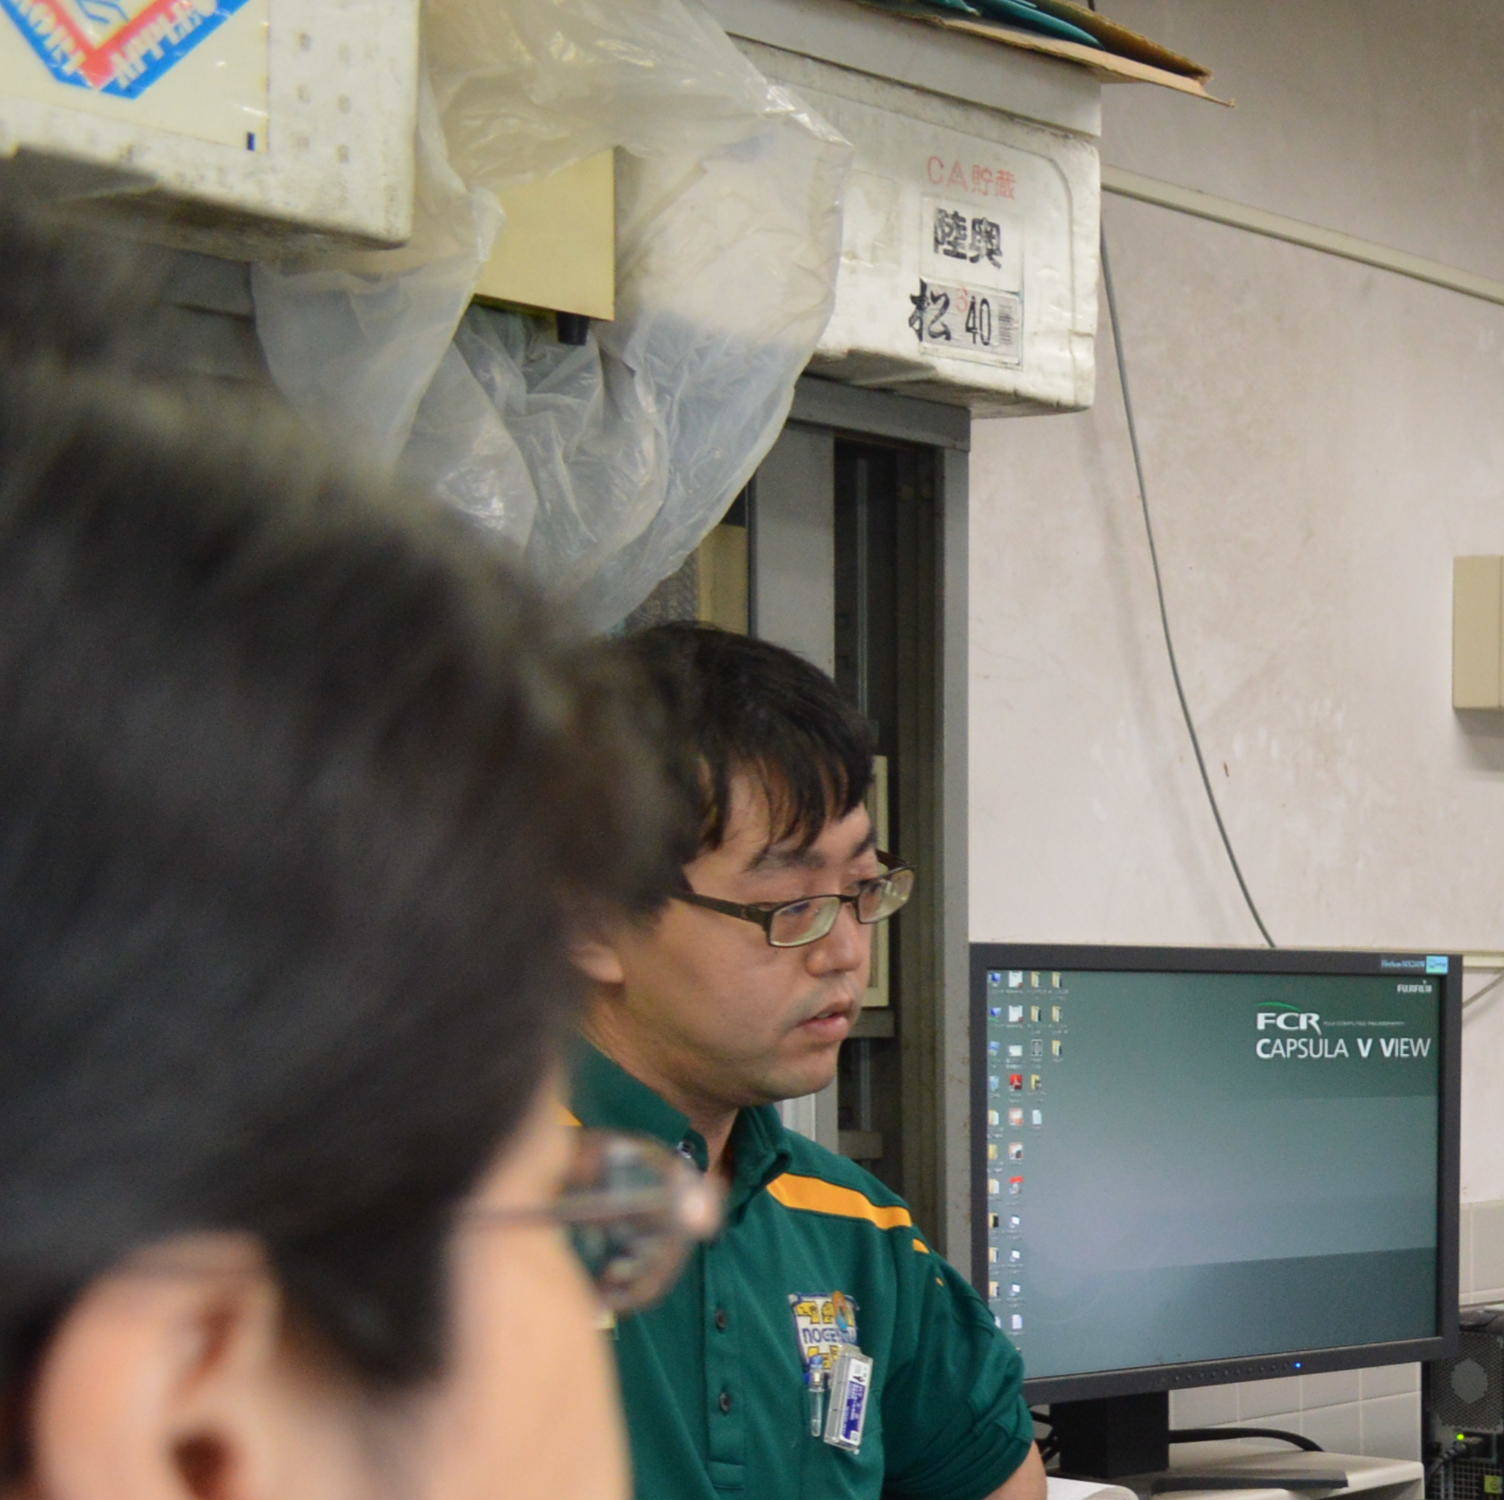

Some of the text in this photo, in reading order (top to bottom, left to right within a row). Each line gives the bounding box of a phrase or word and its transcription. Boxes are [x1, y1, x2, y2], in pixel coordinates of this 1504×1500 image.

[1256, 1012, 1322, 1035] FCR
[1256, 1038, 1431, 1059] CAPSULA V VIEW
